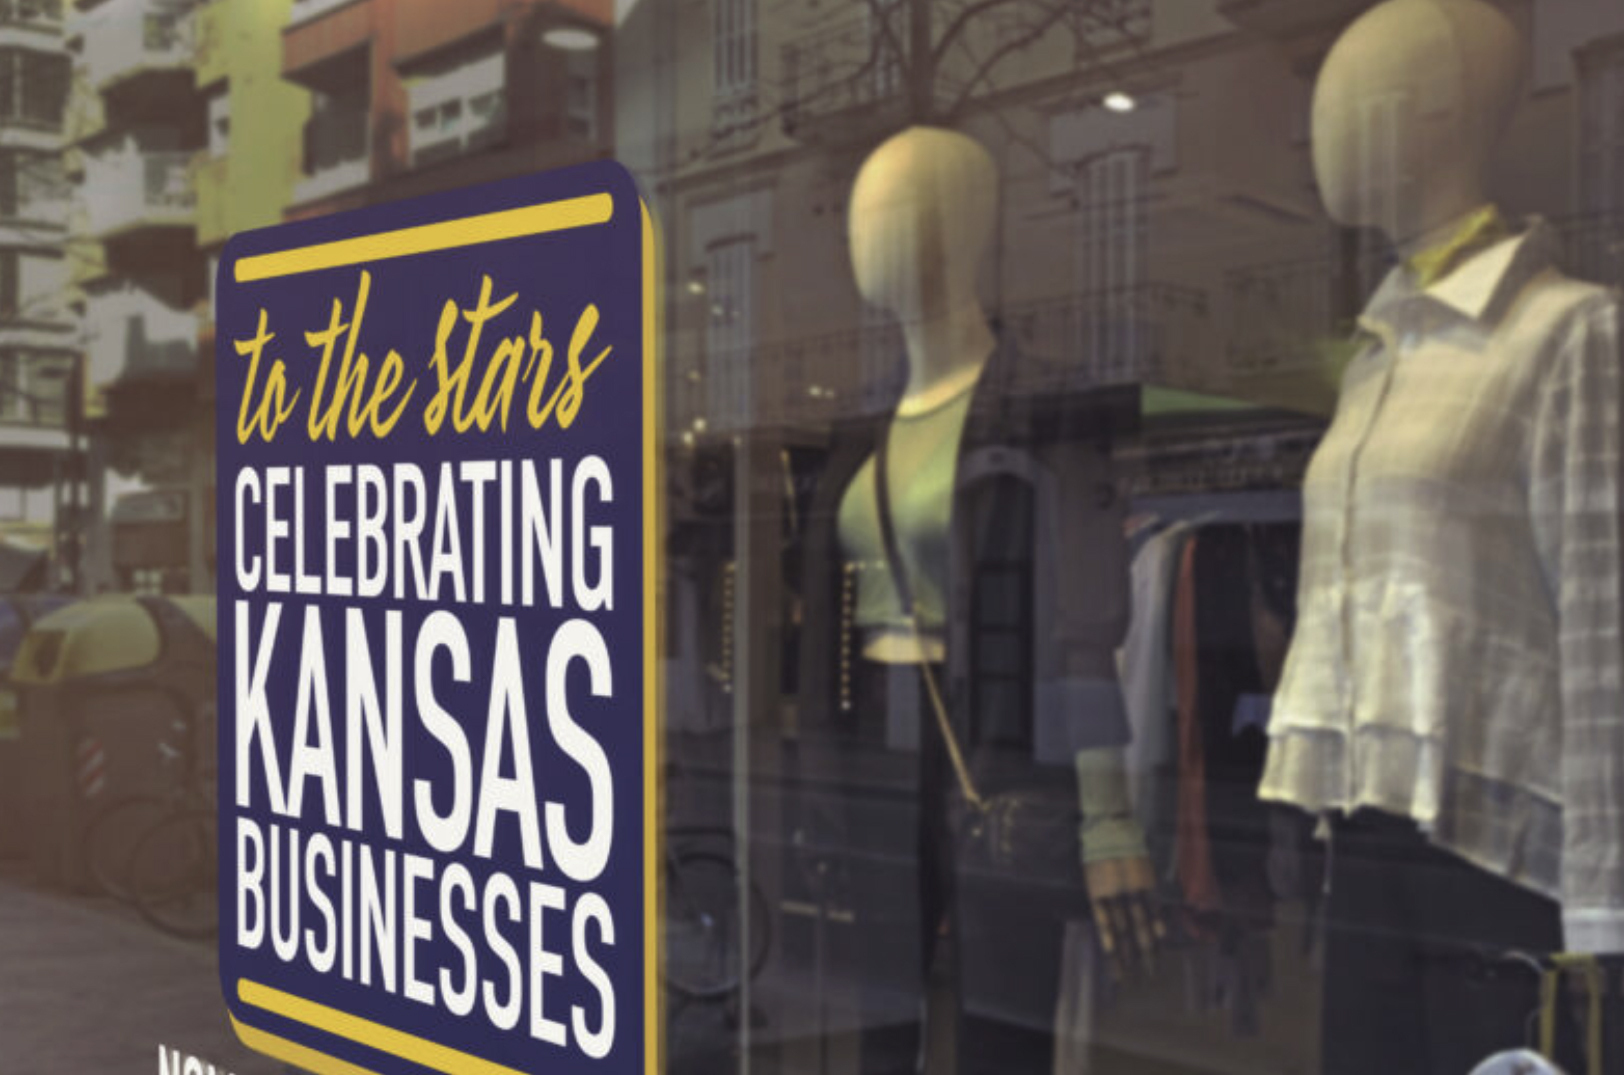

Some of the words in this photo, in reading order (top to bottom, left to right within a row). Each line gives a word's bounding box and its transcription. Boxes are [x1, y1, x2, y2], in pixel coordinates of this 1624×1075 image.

[235, 309, 300, 444] to
[304, 270, 417, 441] the
[423, 275, 612, 436] stars
[235, 454, 614, 611] CELEBRATING
[235, 600, 615, 882] KANSAS
[237, 817, 616, 1059] BUSINESSES
